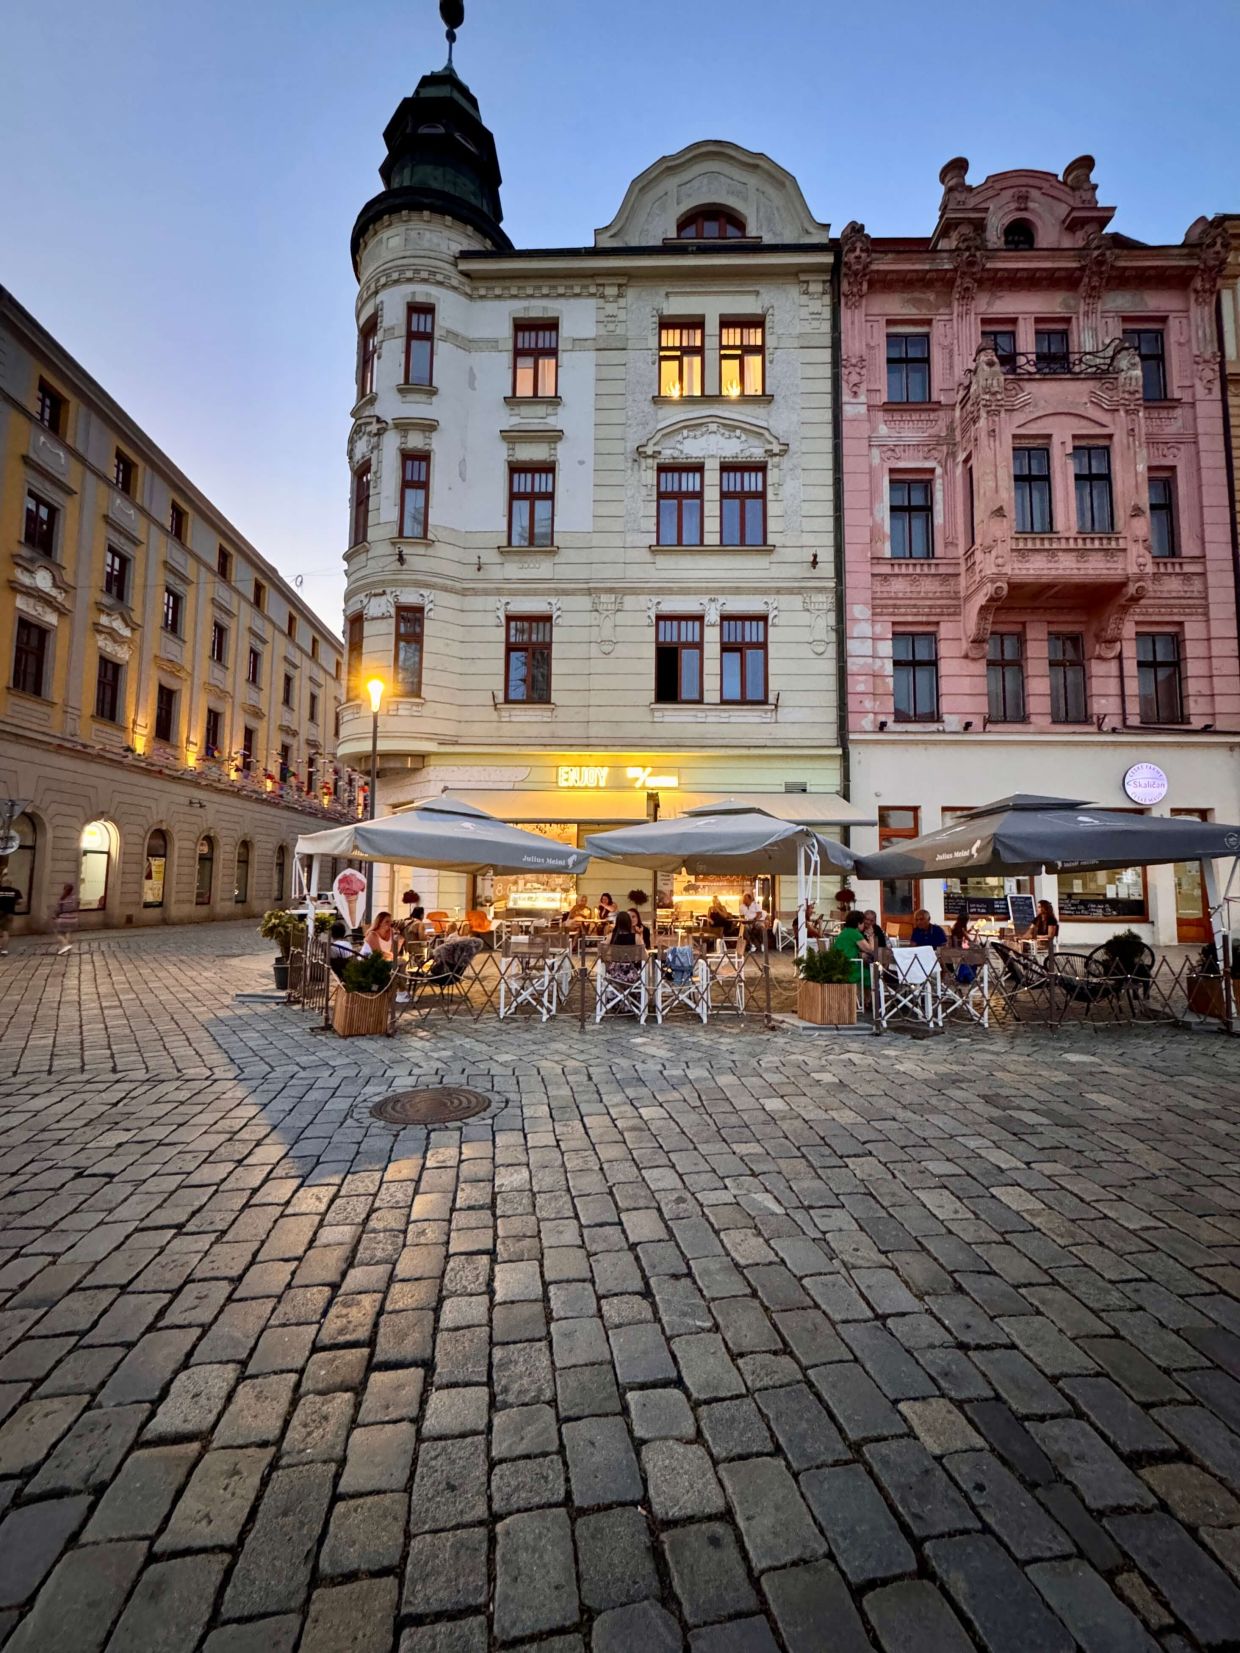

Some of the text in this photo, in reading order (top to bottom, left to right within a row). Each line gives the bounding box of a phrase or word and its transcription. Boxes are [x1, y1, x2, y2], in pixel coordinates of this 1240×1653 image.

[558, 767, 609, 787] ENJOY
[1133, 780, 1166, 789] Skaličan
[522, 855, 545, 864] Julius
[935, 852, 953, 861] Julius
